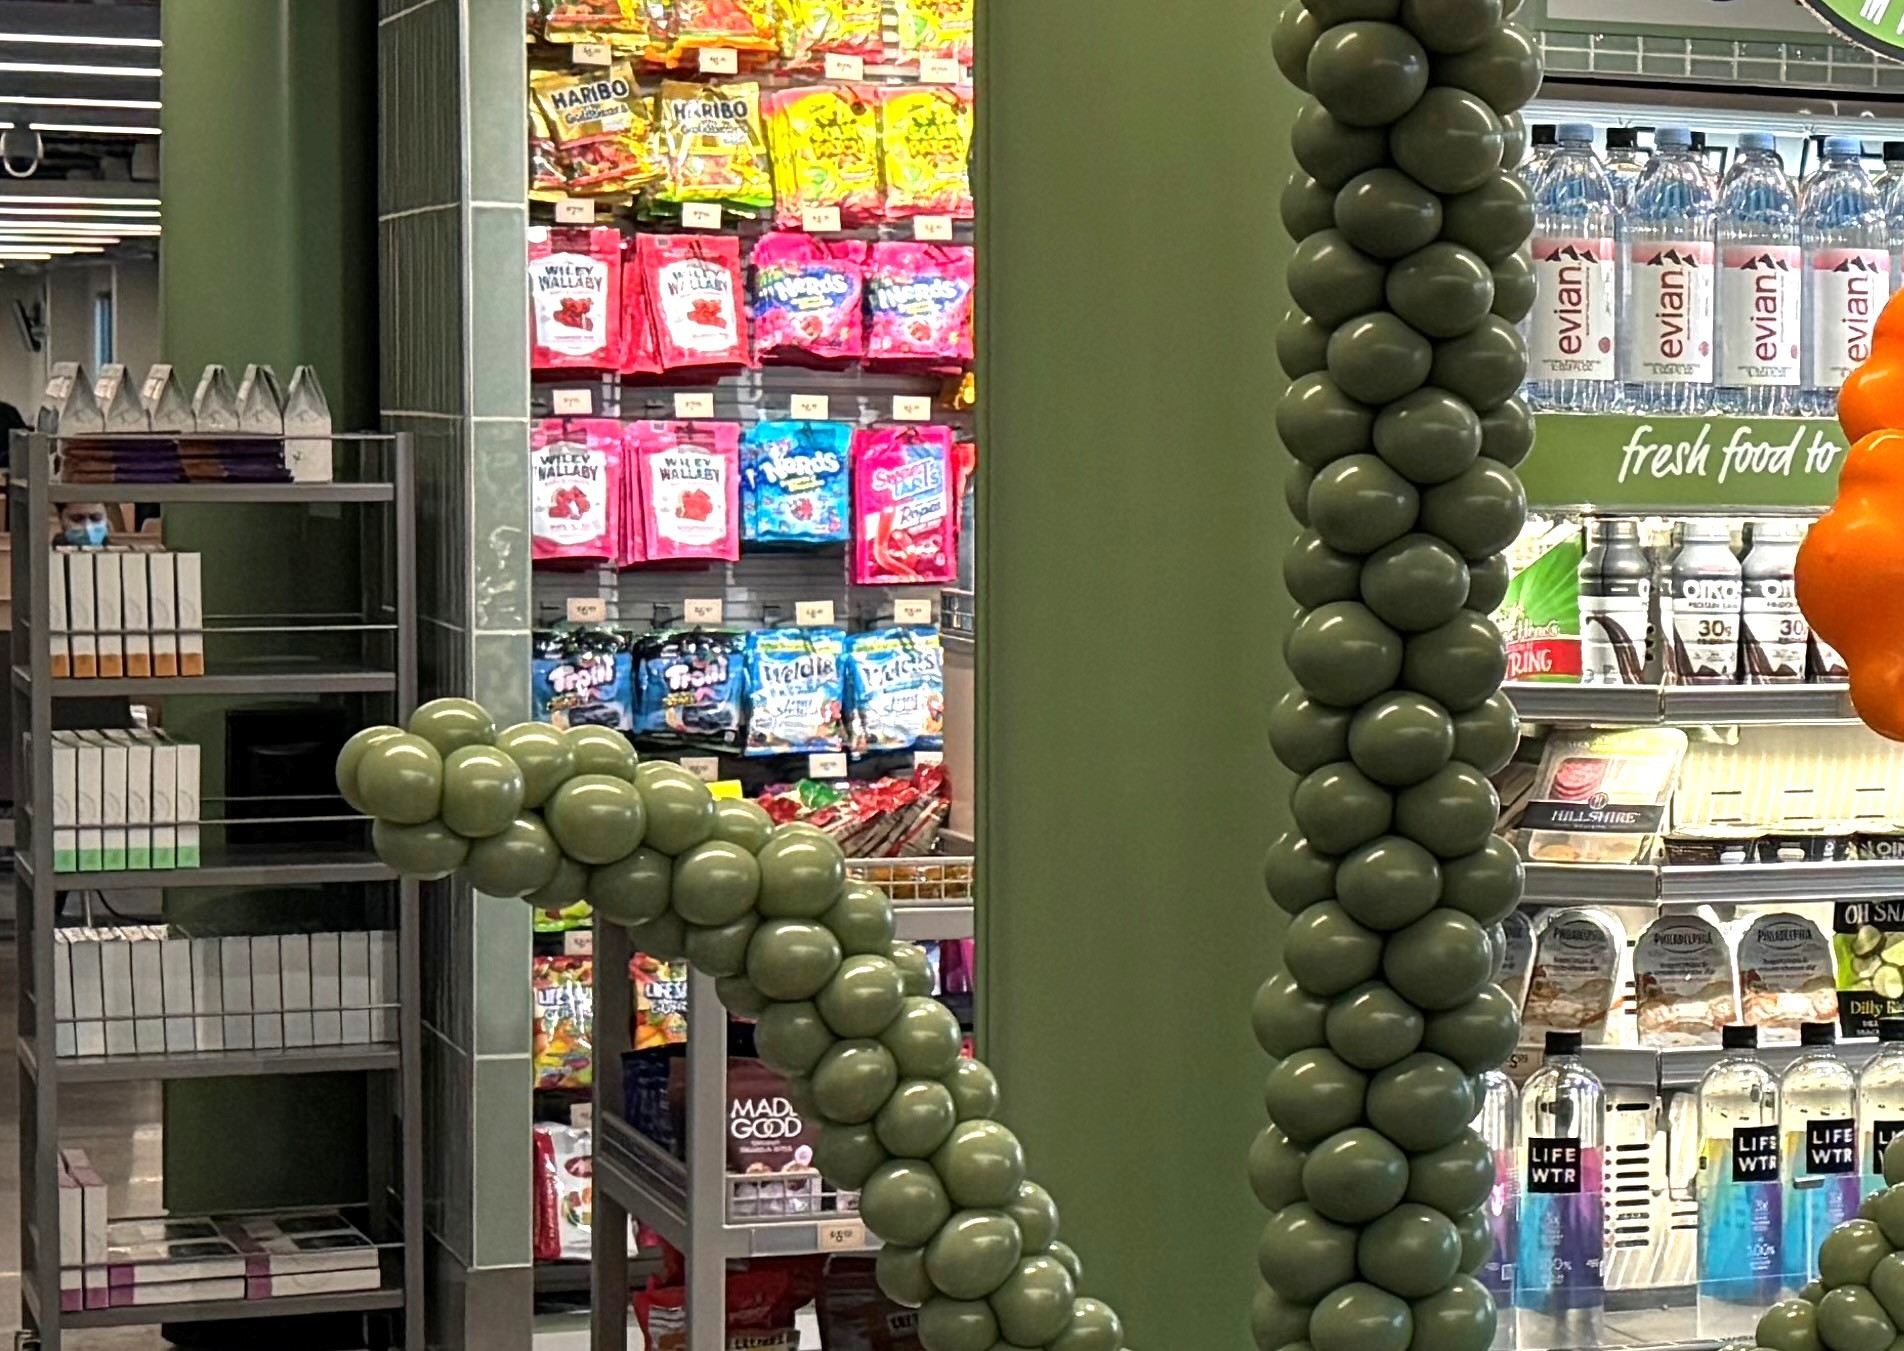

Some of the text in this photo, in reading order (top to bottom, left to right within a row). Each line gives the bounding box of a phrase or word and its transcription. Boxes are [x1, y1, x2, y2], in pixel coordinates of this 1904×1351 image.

[550, 79, 629, 109] HARIBO
[1553, 263, 1584, 356] evian
[1654, 269, 1686, 359] evian
[1749, 275, 1779, 362] evian
[1841, 275, 1870, 363] evian
[1618, 424, 1709, 484] fresh
[1718, 426, 1801, 485] food
[1805, 431, 1842, 476] to
[659, 468, 721, 483] WALLABY
[1506, 649, 1553, 674] TRING
[1551, 810, 1639, 826] HILLSHIRE
[1844, 903, 1870, 924] OH
[1850, 999, 1884, 1019] Dilly
[730, 1118, 802, 1139] GOOD
[1811, 1127, 1854, 1144] LIFE
[1531, 1146, 1577, 1163] LIFE
[1811, 1147, 1853, 1164] WTR
[1530, 1167, 1577, 1185] WTR
